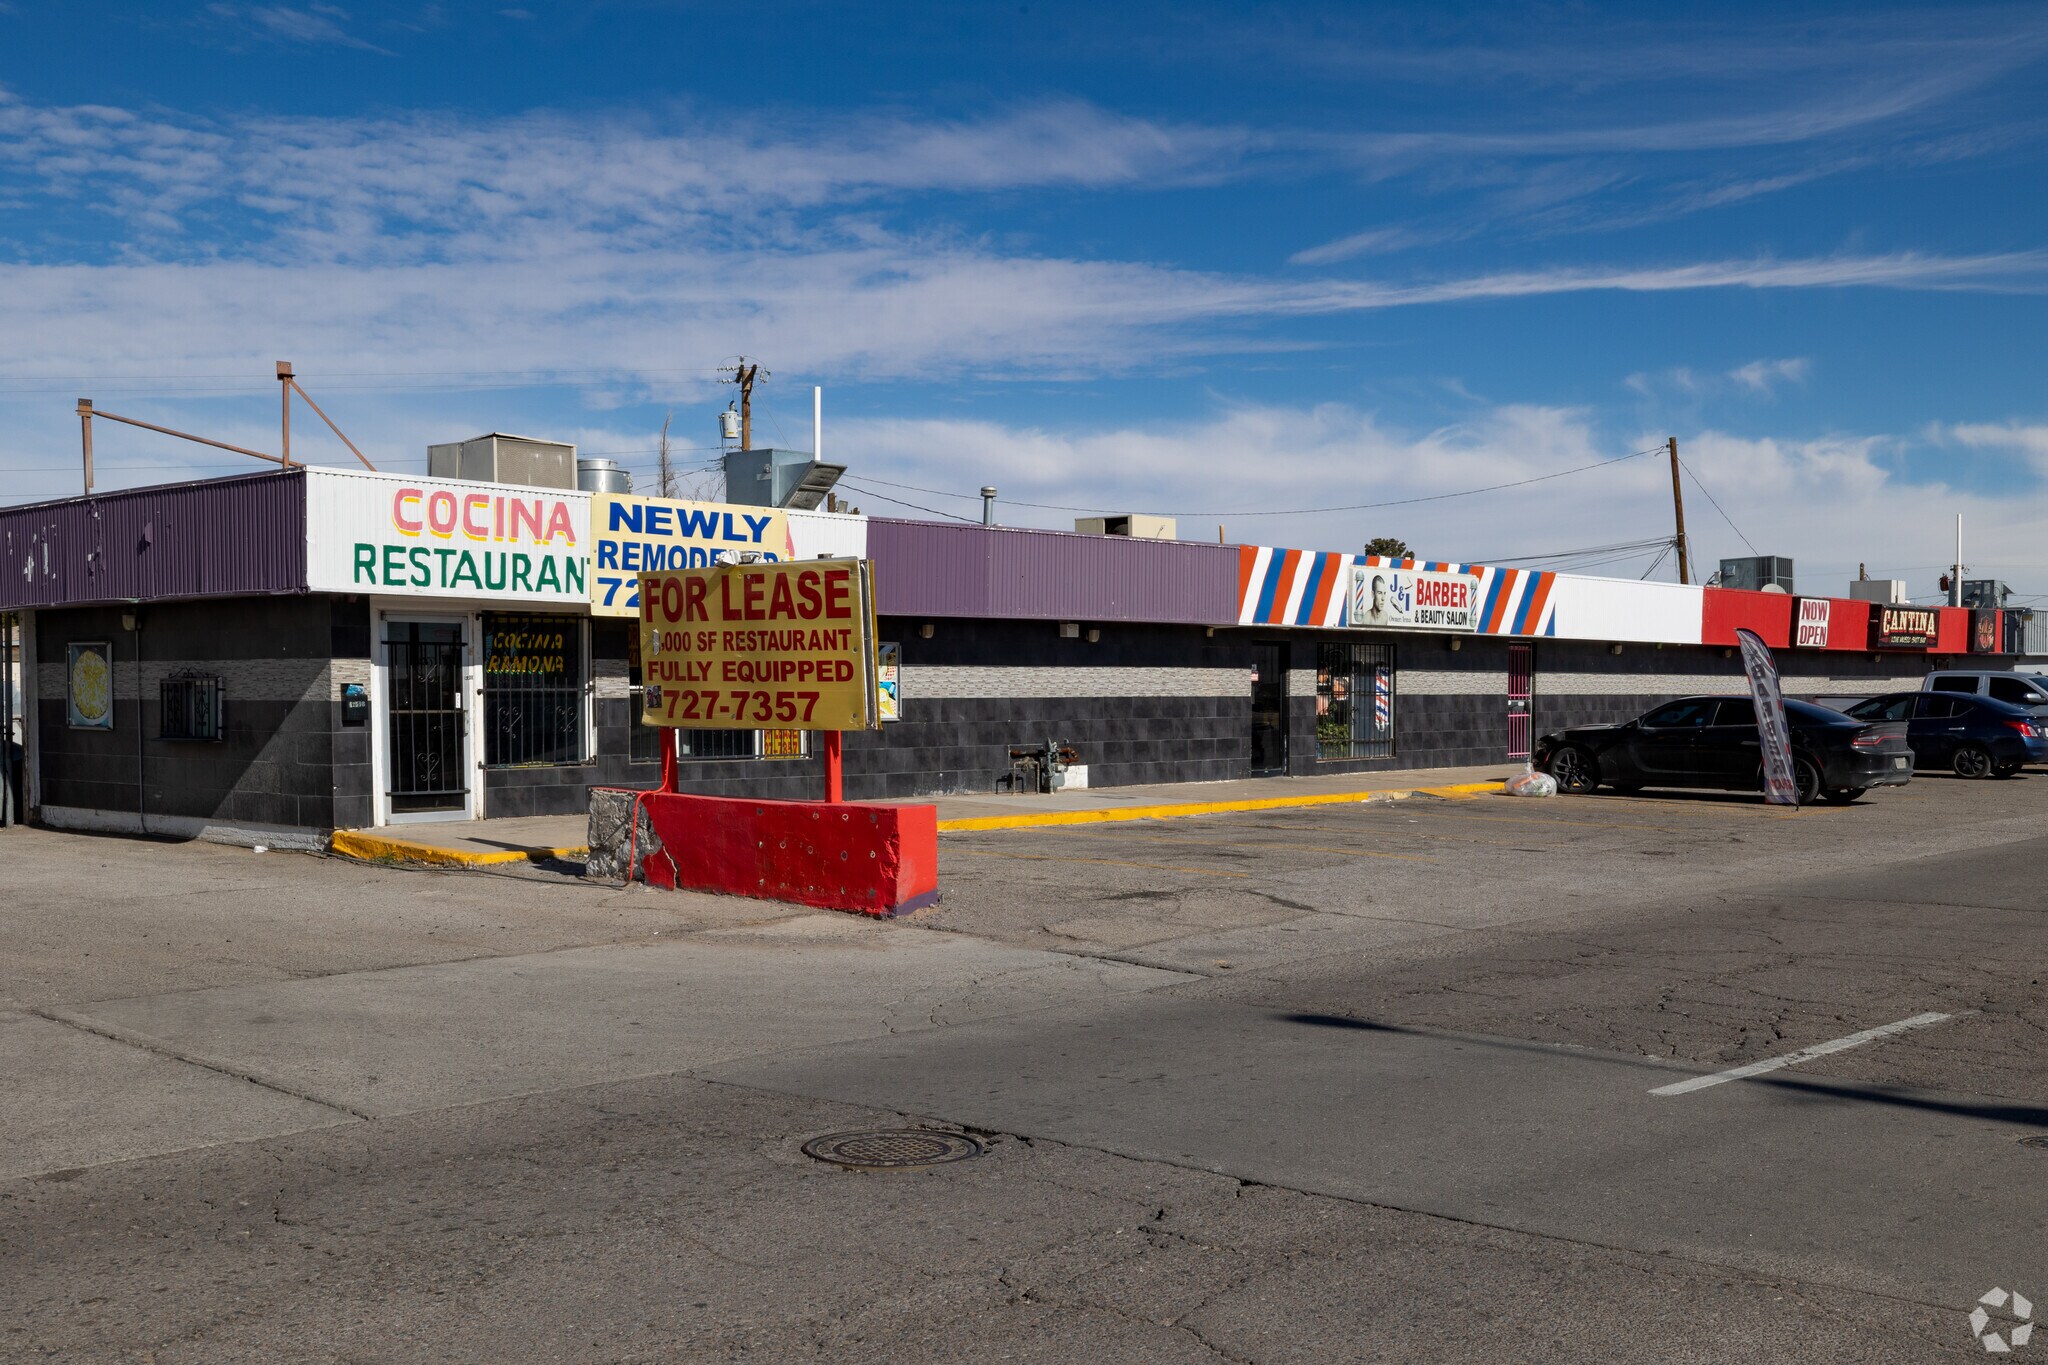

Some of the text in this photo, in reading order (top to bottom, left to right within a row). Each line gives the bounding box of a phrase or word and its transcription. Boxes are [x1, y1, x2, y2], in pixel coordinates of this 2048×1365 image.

[391, 488, 577, 546] COCINA
[609, 502, 773, 543] NEWLY
[354, 543, 590, 594] RESTAURAN
[644, 570, 852, 623] FOR LEASE
[1390, 574, 1398, 592] J
[1405, 593, 1410, 611] I
[1416, 578, 1467, 608] BARBER
[1415, 610, 1468, 625] & BEAUTY SALON
[1801, 601, 1828, 621] NOW
[1883, 610, 1936, 636] CANTINA
[493, 633, 563, 649] COCINA
[697, 631, 717, 651] SF
[723, 629, 852, 651] RESTAURANT
[1799, 625, 1827, 645] OPEN
[487, 655, 564, 673] RAMONA
[648, 660, 854, 683] FULLY EQUIPPED
[663, 689, 820, 722] 727-7357
